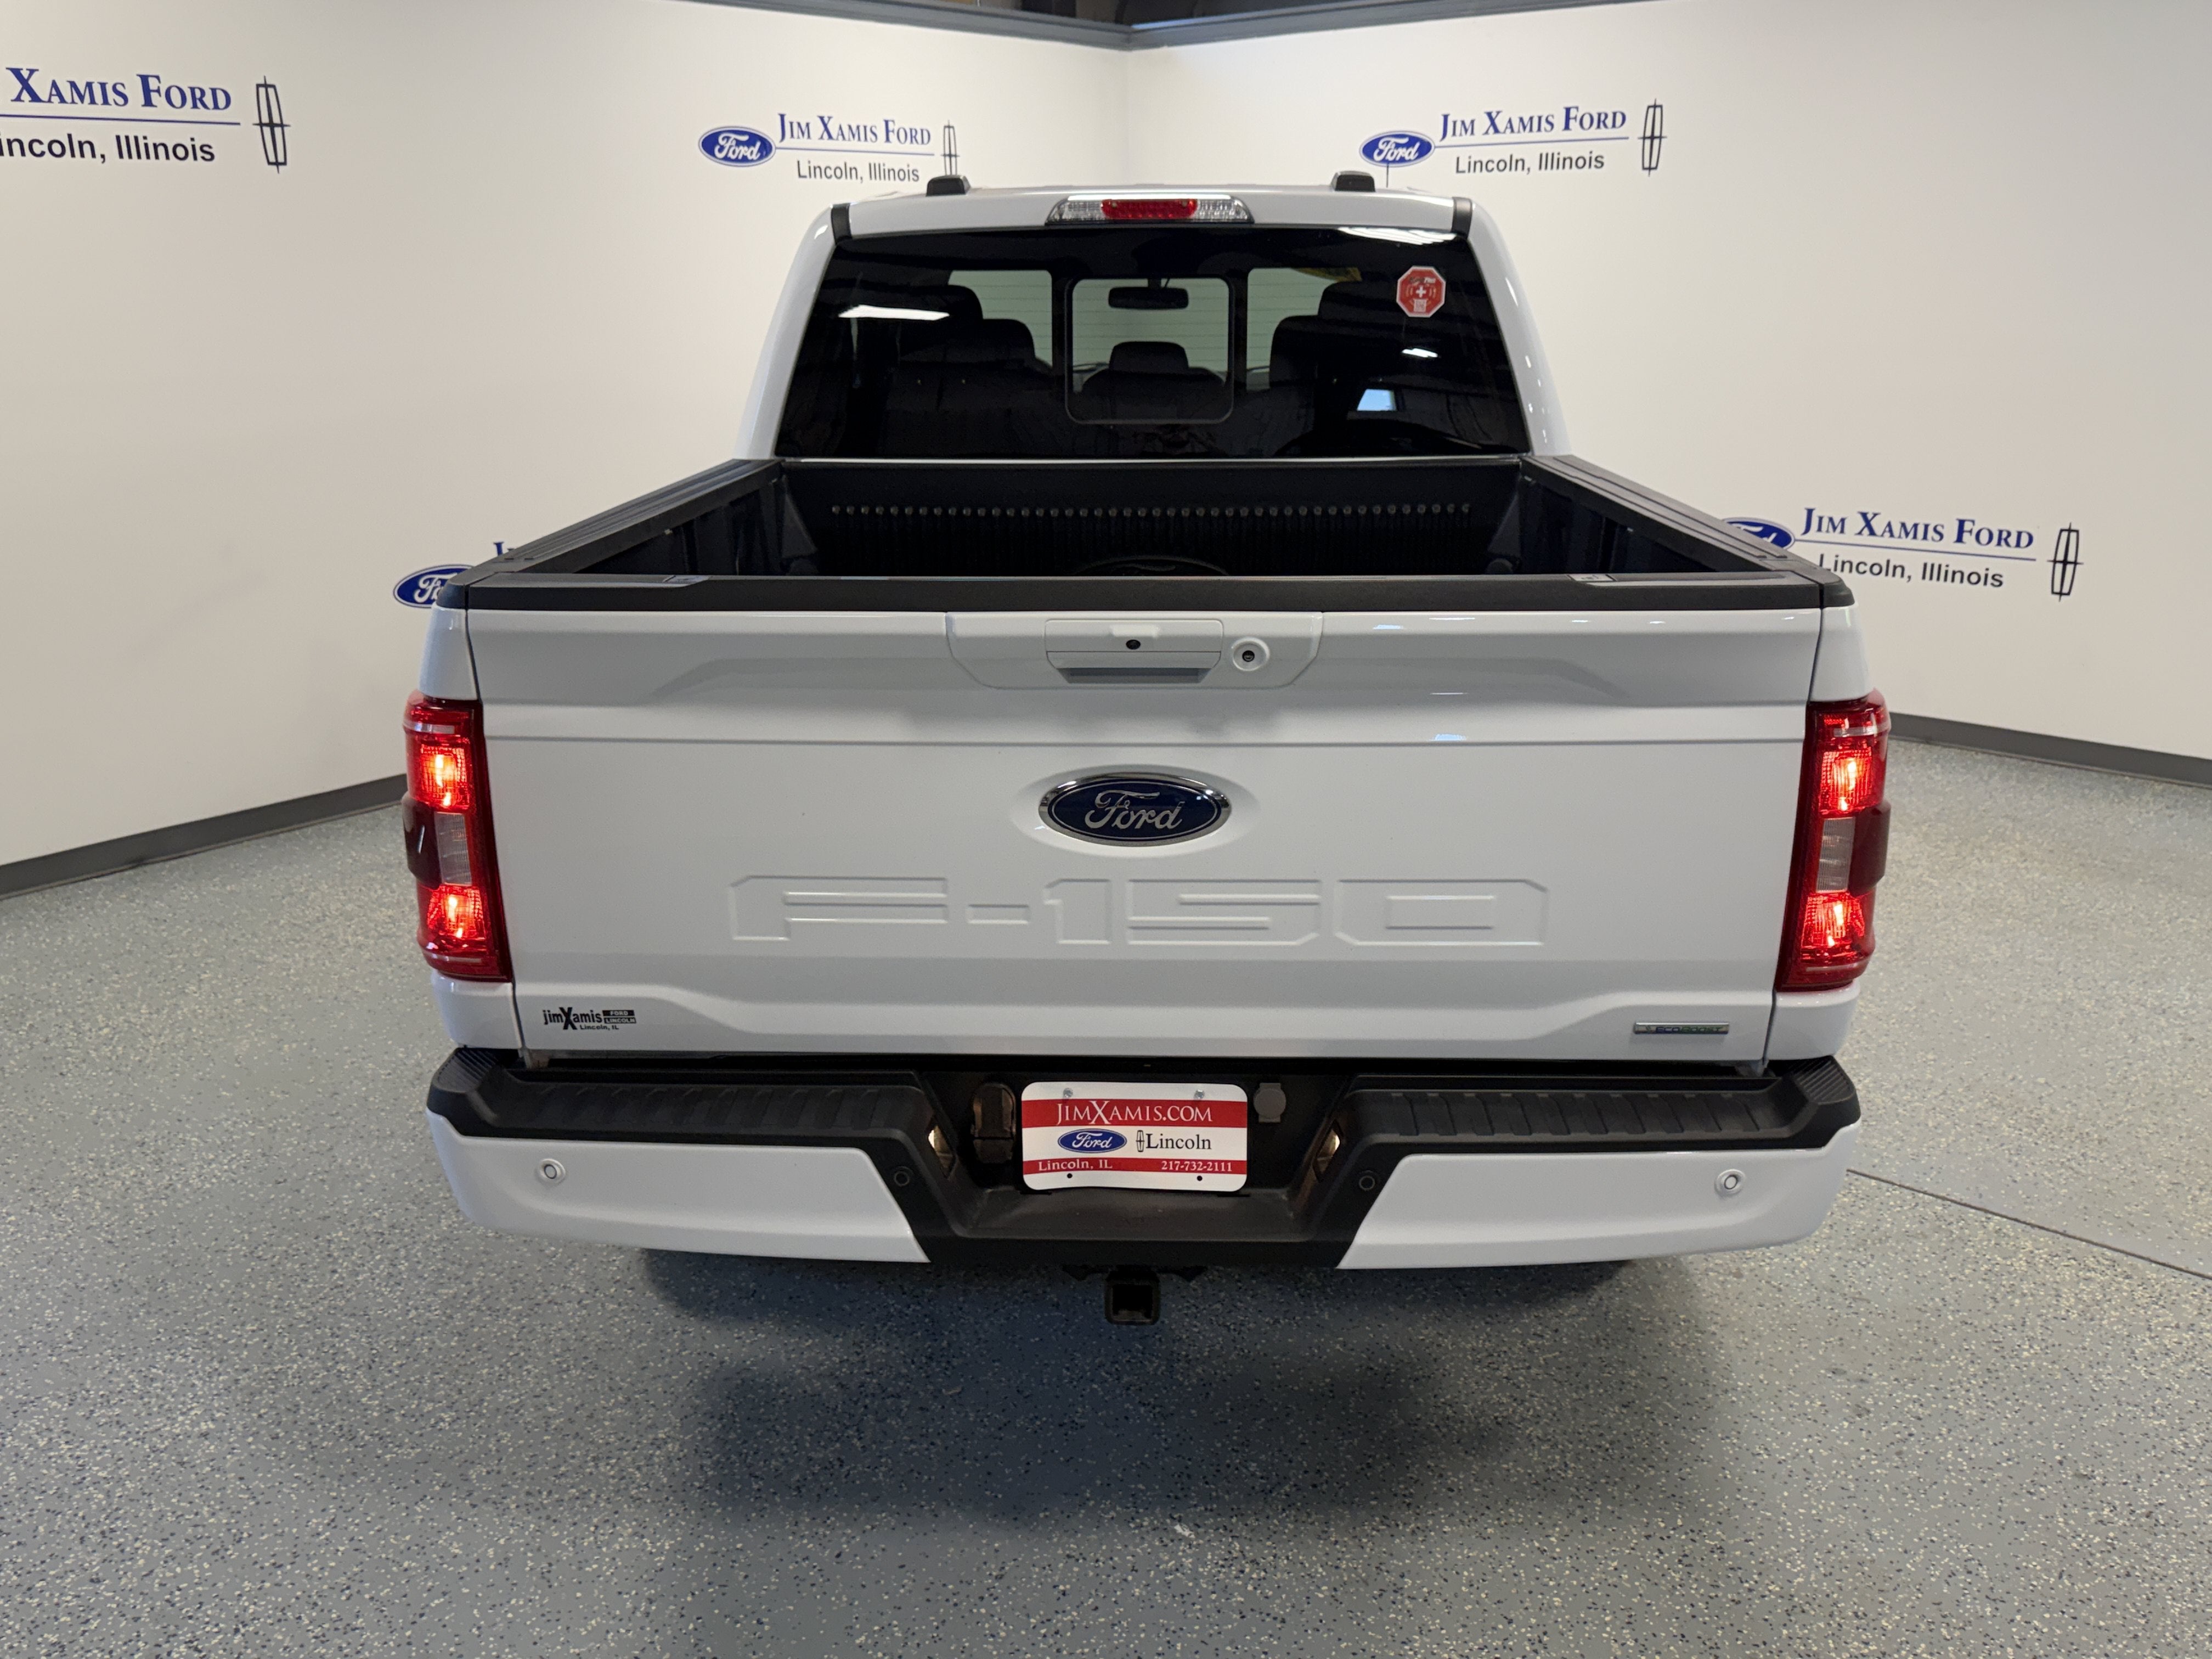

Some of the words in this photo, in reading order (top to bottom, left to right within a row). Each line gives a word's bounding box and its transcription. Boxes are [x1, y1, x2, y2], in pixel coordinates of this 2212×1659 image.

[0, 132, 106, 163] incoln,
[115, 135, 215, 162] Illinois
[714, 133, 760, 160] Ford
[1373, 137, 1419, 162] Ford
[797, 160, 863, 183] Lincoln,
[868, 163, 919, 182] Illinois
[1455, 154, 1531, 174] Lincoln,
[1538, 151, 1605, 171] Illinois
[1921, 562, 2004, 587] Illinois
[1085, 789, 1185, 830] Ford
[730, 876, 1547, 945] F-150
[1072, 1132, 1111, 1149] Ford
[1146, 1133, 1212, 1150] Lincoln
[1039, 1159, 1093, 1171] Lincoln,
[1099, 1159, 1113, 1169] IL
[1161, 1161, 1232, 1172] 217-732-2111
